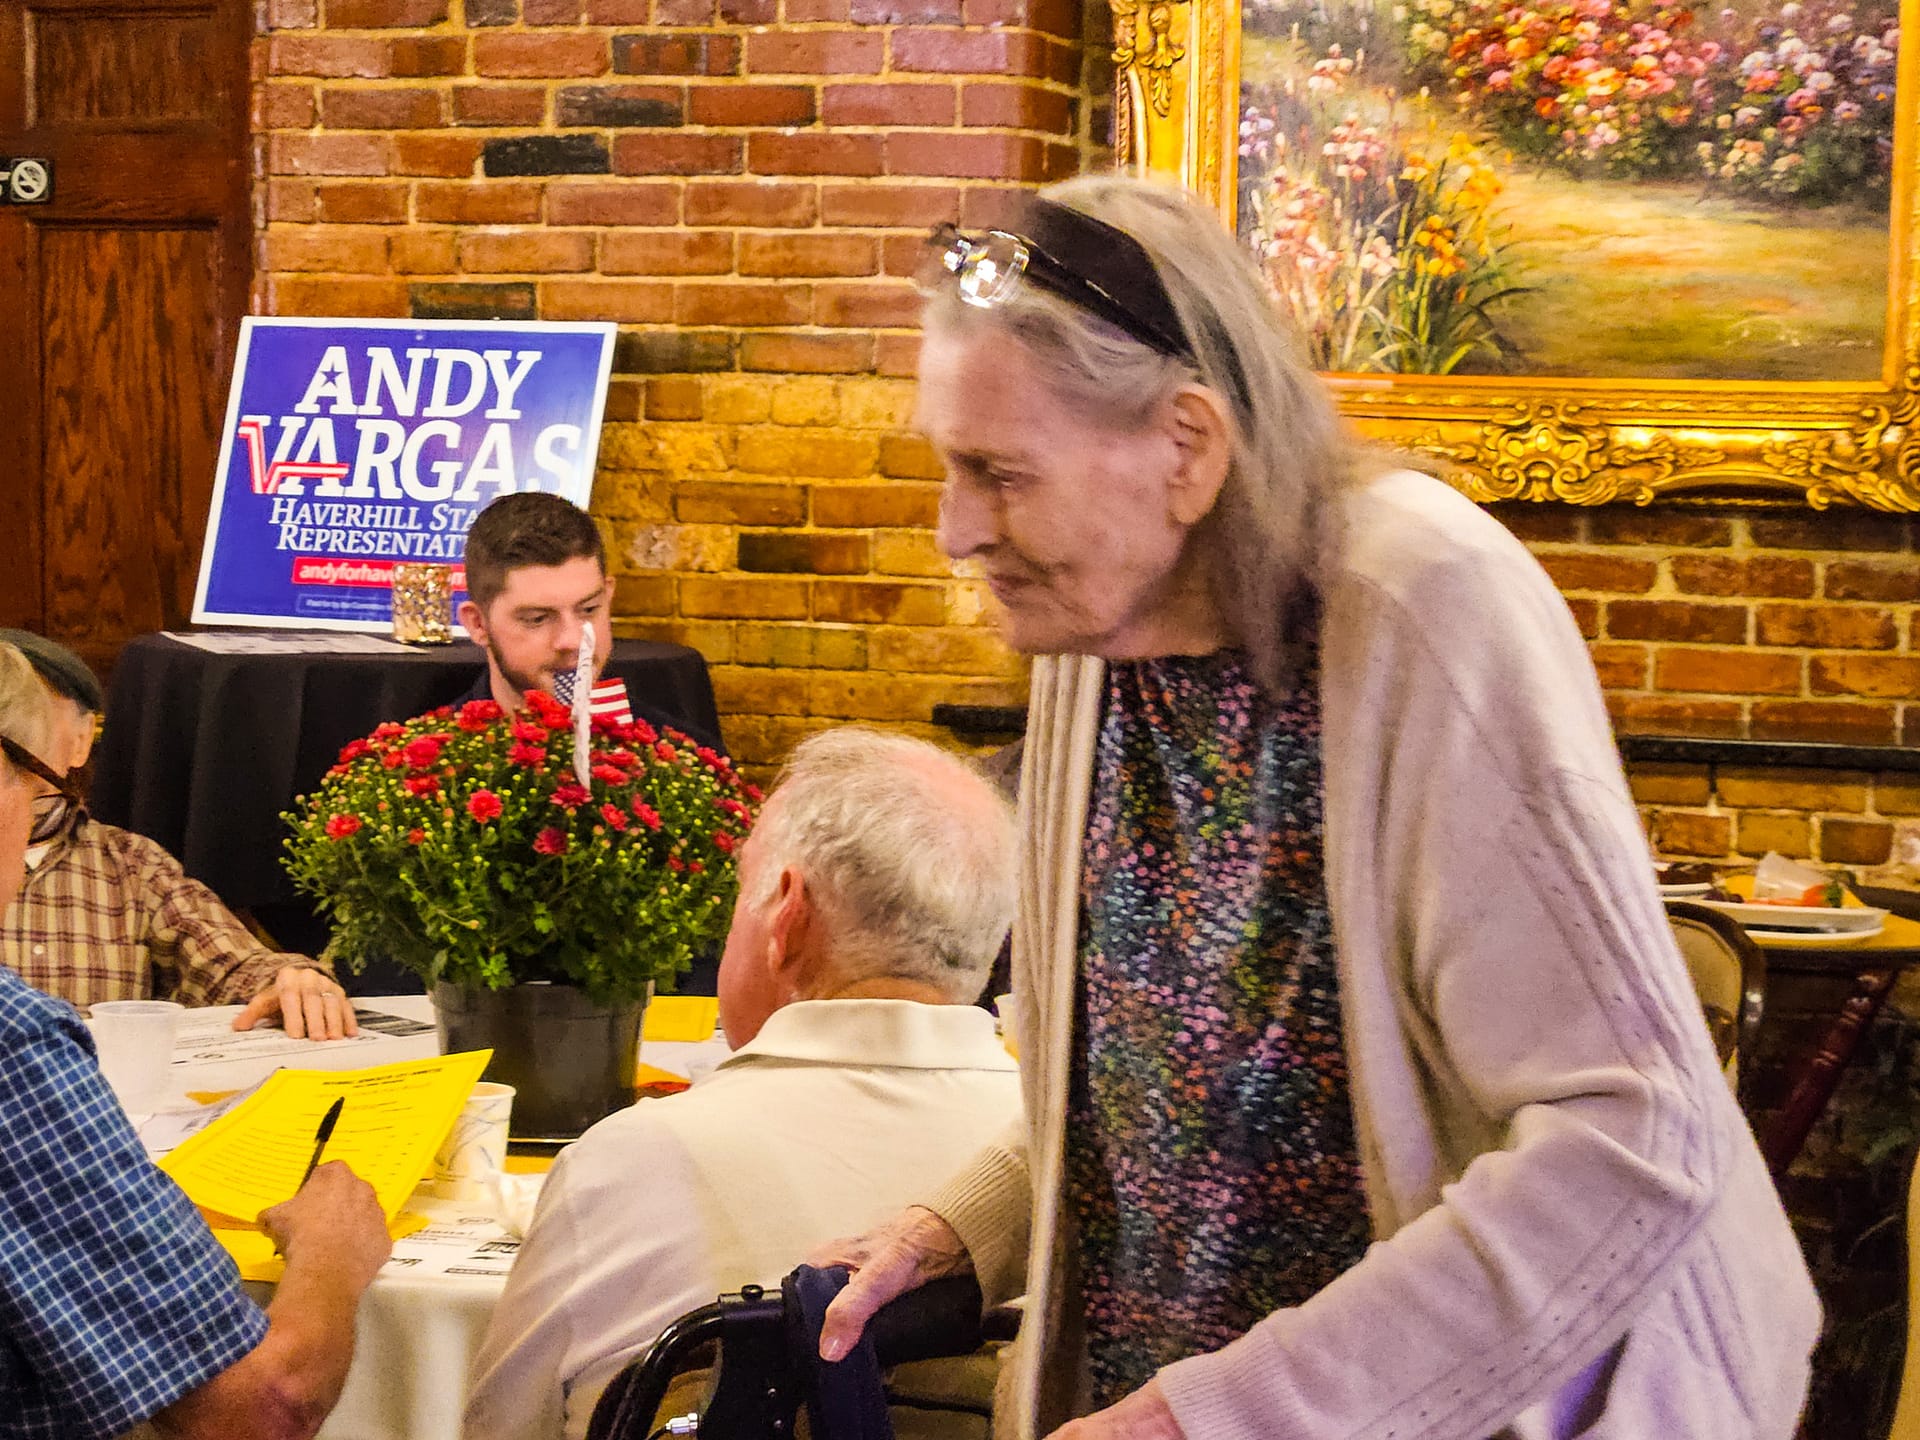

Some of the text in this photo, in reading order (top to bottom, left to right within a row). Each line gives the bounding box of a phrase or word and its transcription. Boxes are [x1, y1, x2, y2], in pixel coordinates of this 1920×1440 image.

[295, 346, 542, 420] ANDY
[238, 415, 583, 502] VARGAS
[268, 497, 478, 532] HAVERHILL STA
[276, 523, 469, 558] REPRESENTATI
